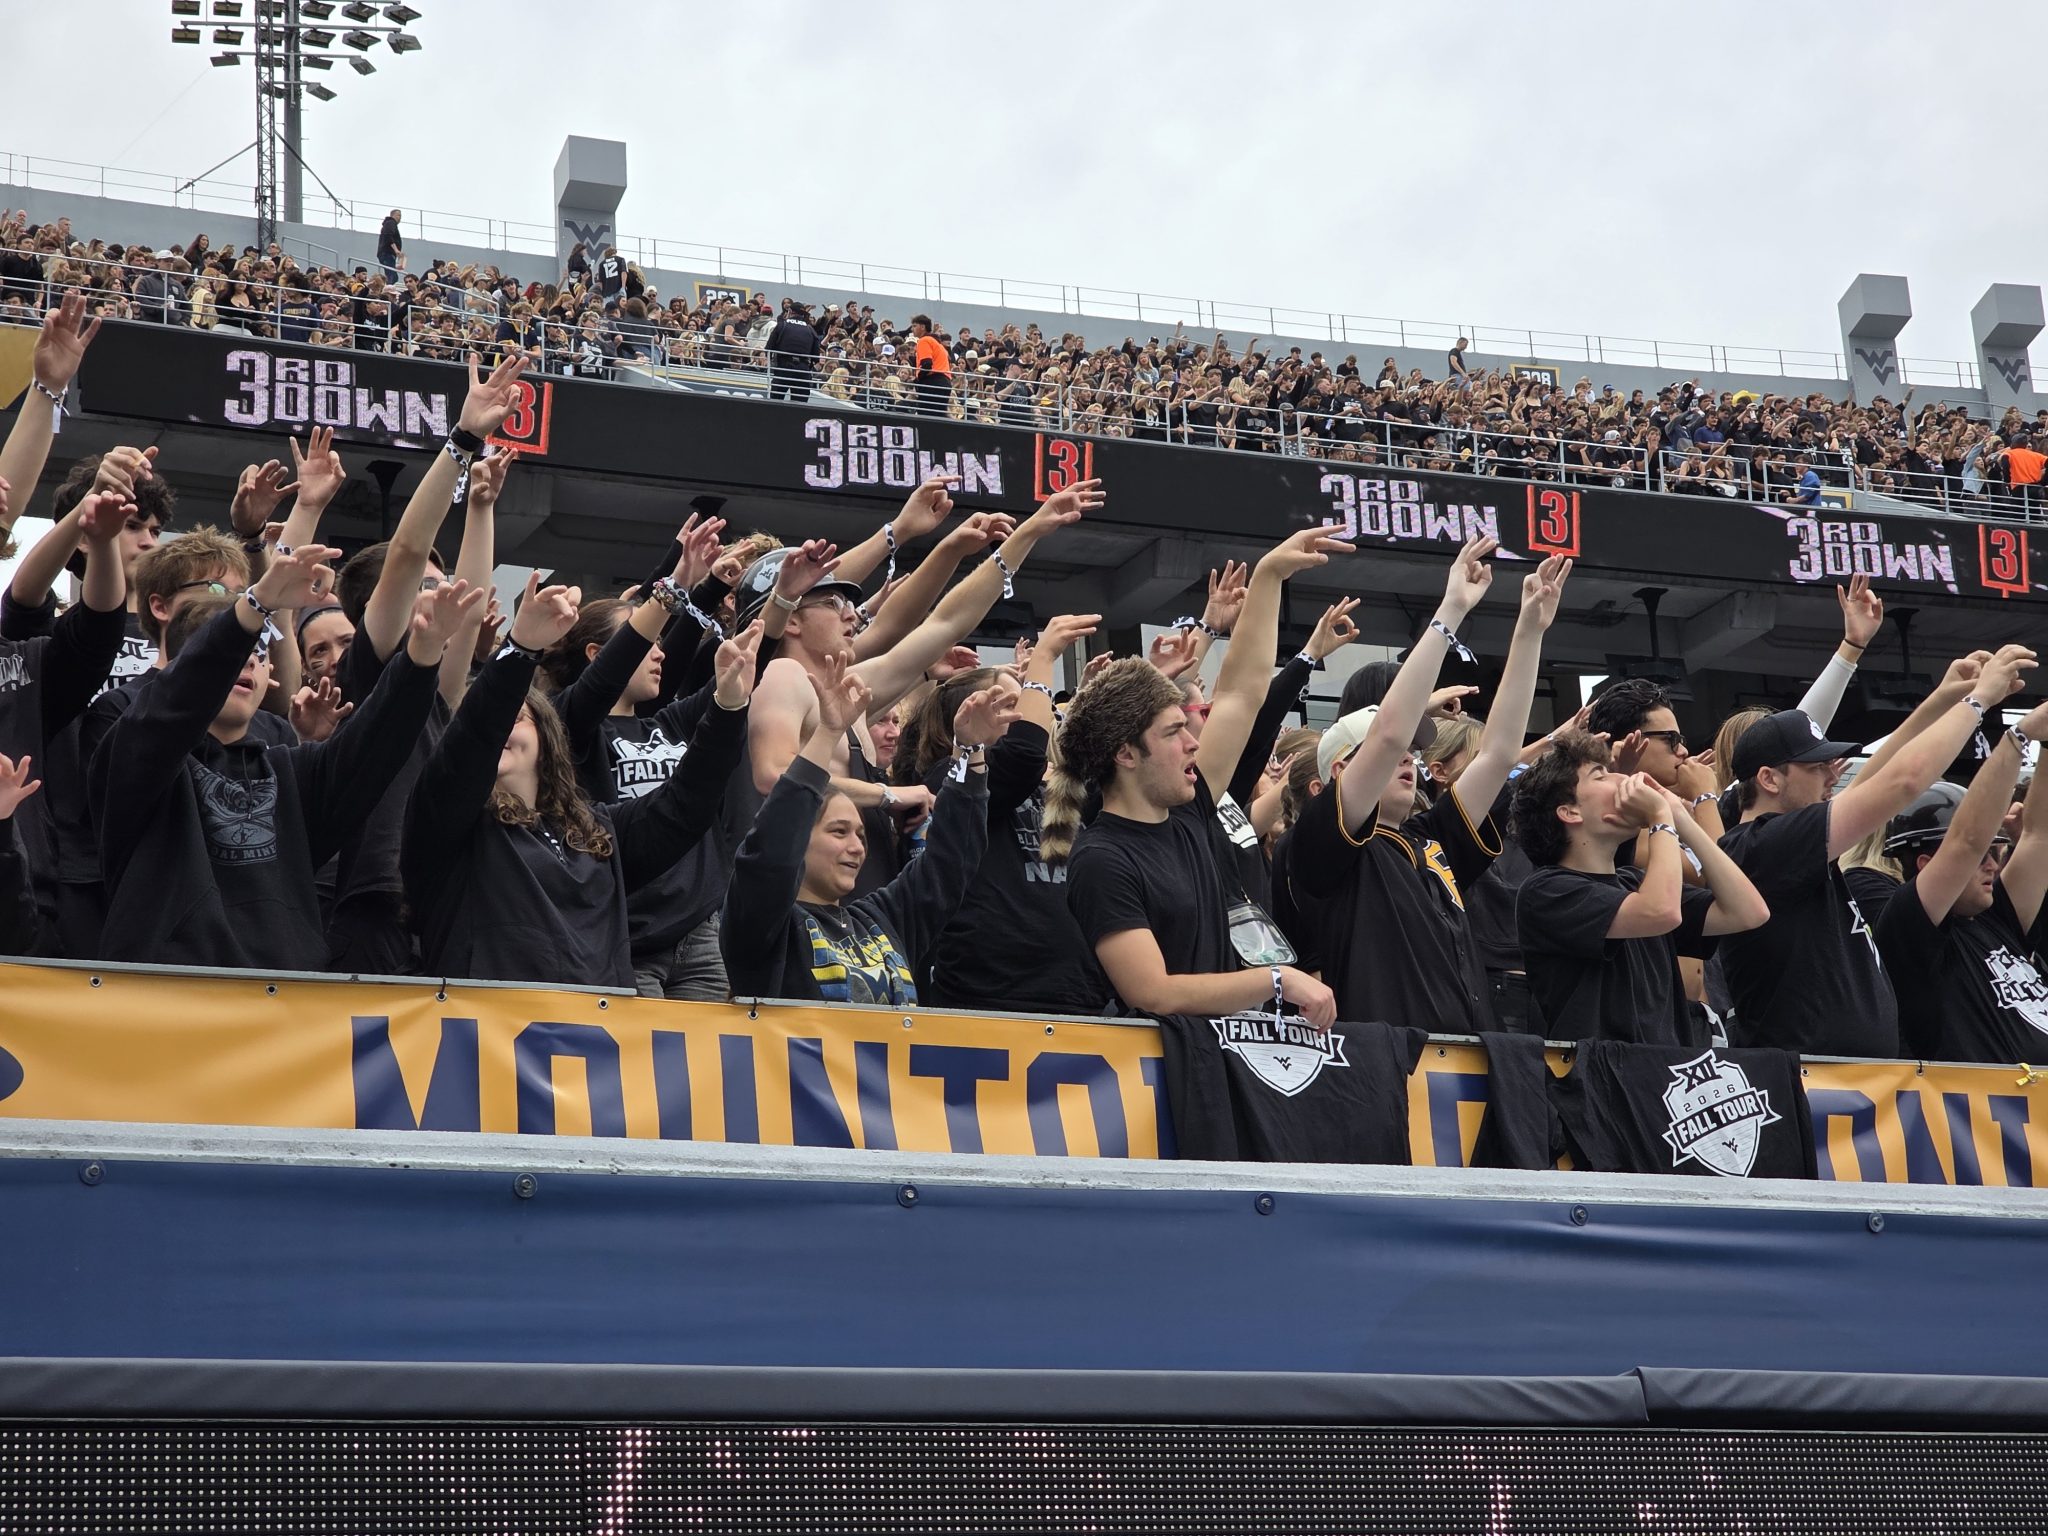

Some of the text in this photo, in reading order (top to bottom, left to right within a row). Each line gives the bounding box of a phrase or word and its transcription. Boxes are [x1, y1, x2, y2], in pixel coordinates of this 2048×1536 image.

[603, 261, 619, 278] 12
[274, 382, 449, 437] DOWN
[501, 380, 537, 438] 3
[848, 447, 1002, 495] DOWN
[1049, 440, 1079, 493] 3
[1360, 500, 1500, 544] DOWN
[1540, 490, 1568, 543] 3
[1824, 543, 1955, 582] DOWN
[1990, 529, 2018, 580] 3
[623, 760, 666, 783] FALL
[243, 841, 277, 859] MINE
[1017, 832, 1041, 847] BLA
[1024, 862, 1068, 884] NA
[1229, 1020, 1275, 1042] FALL
[1674, 1054, 1723, 1095] XII
[1676, 1094, 1759, 1144] FALL TOUR
[1683, 1084, 1736, 1113] 2026
